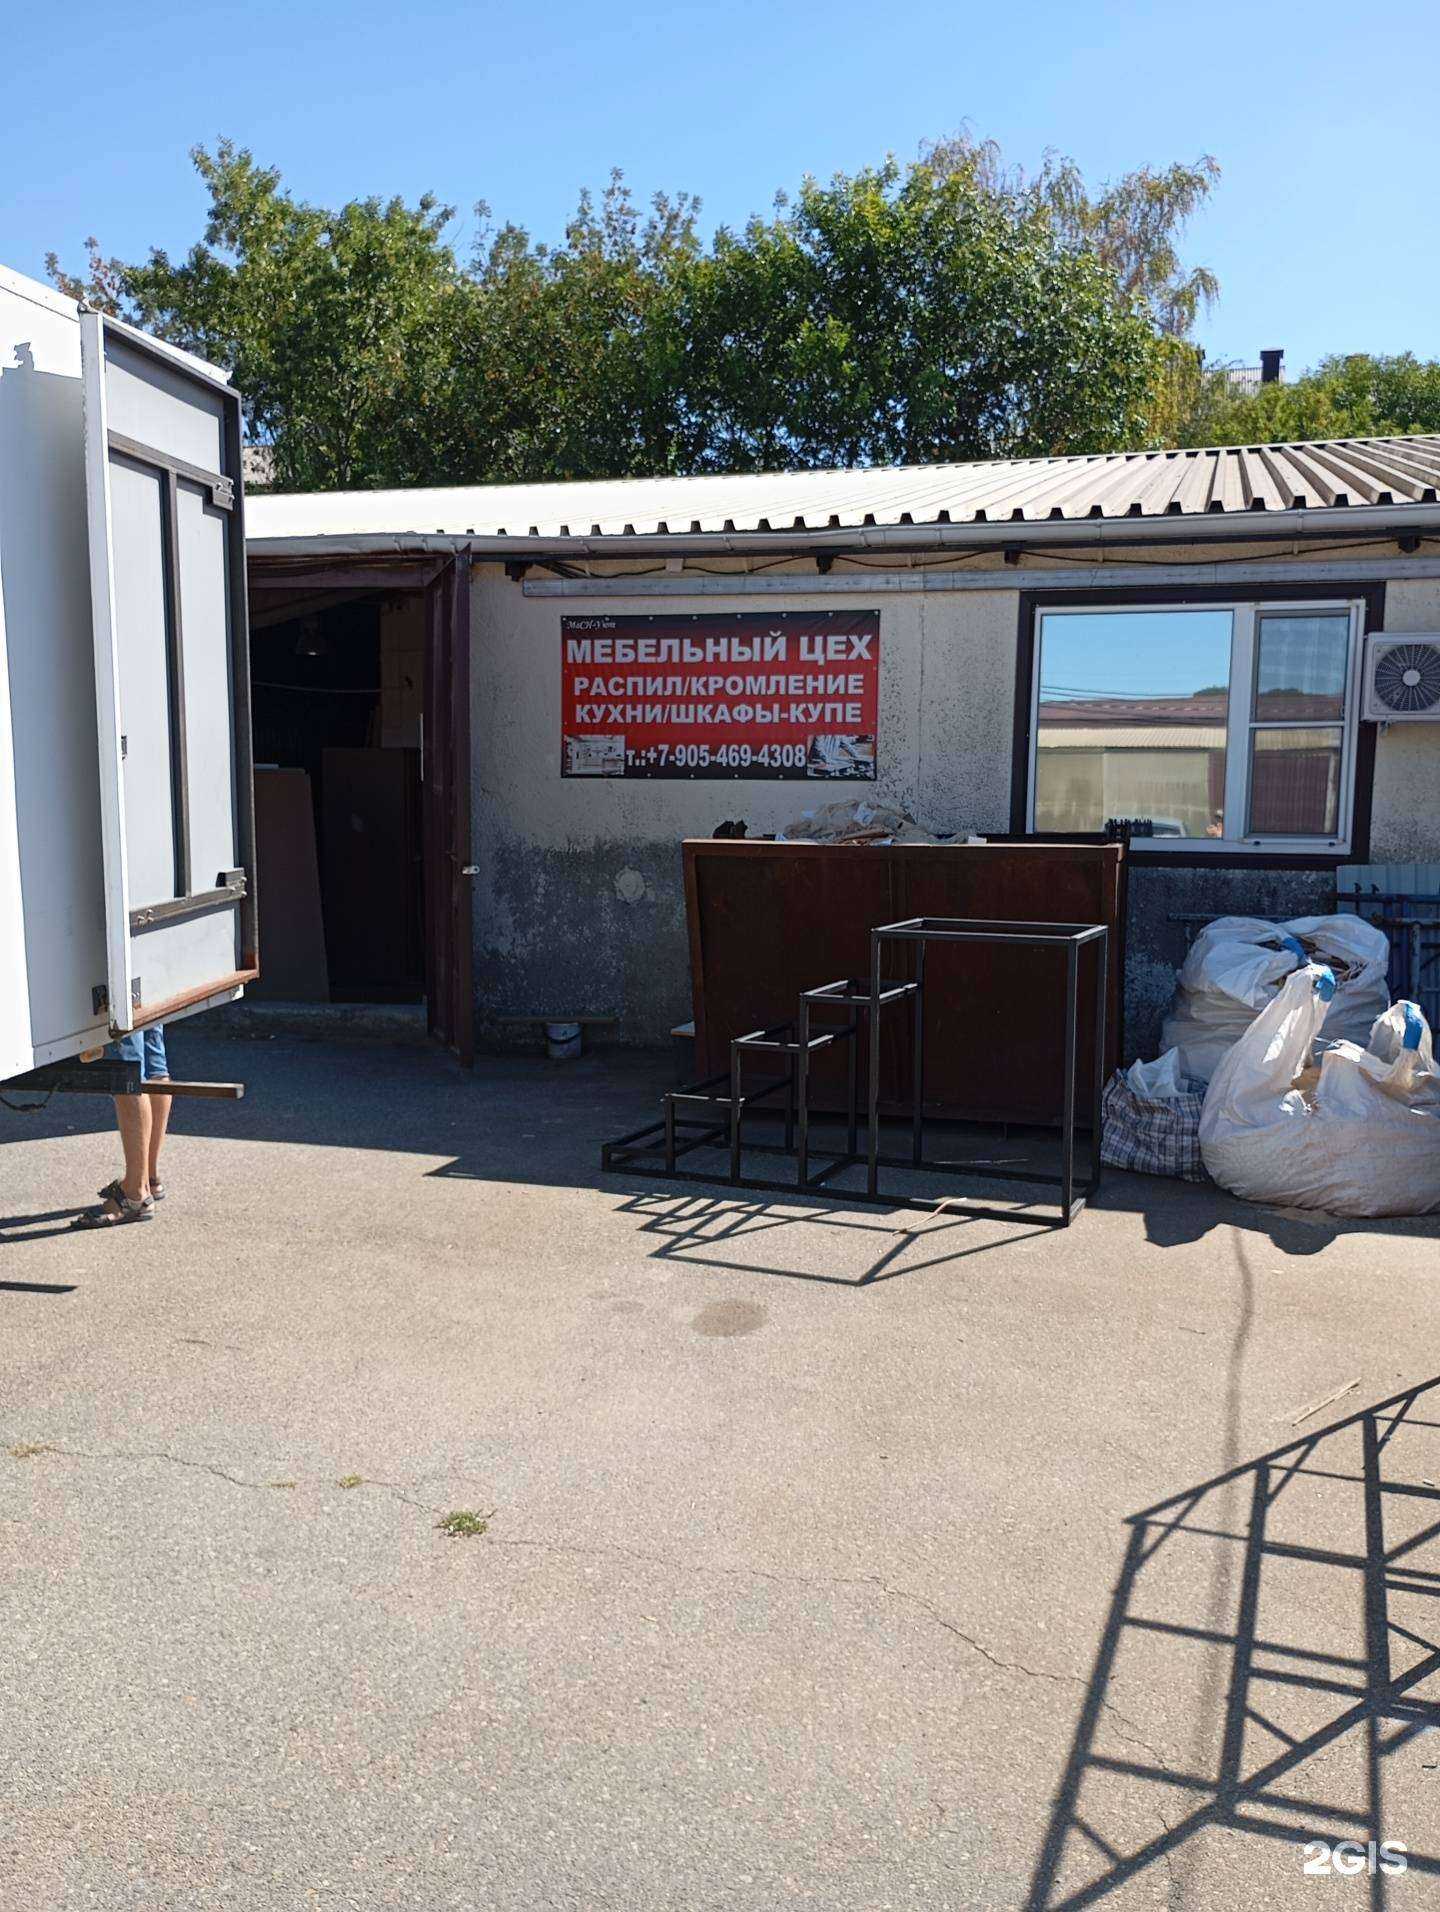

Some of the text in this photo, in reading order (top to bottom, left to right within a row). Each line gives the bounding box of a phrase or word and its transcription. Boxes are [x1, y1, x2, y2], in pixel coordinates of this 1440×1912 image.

[566, 630, 872, 665] МЕБЕЛЬНЫЙ ЦЕХ
[574, 674, 865, 697] РАСПИЛ/КРОМЛЕНИЕ
[575, 702, 862, 724] КУХНИ/ШКАФЫ-КУПЕ
